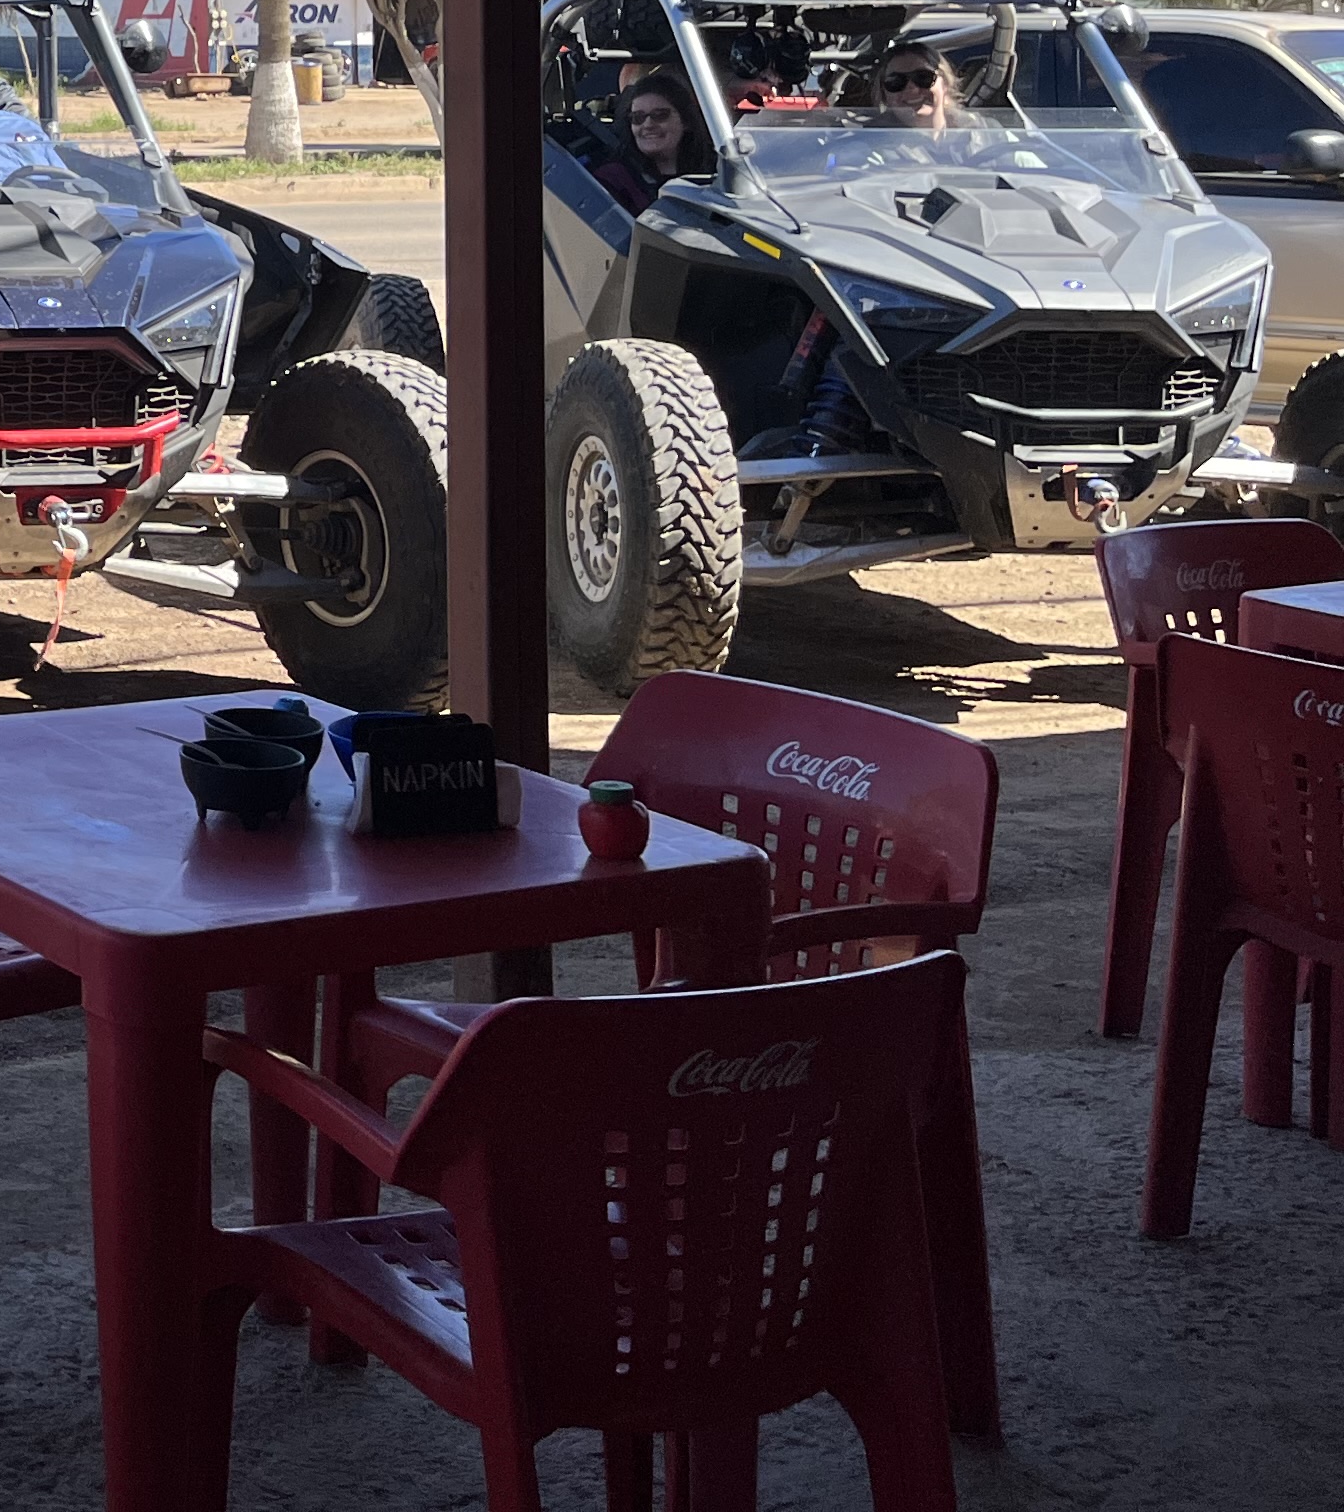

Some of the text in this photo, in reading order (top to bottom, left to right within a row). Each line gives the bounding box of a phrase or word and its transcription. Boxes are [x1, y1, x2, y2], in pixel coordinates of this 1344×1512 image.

[383, 759, 484, 793] NAPKIN
[766, 740, 880, 801] Coca-Cola
[667, 1036, 823, 1098] Coca-Cola
